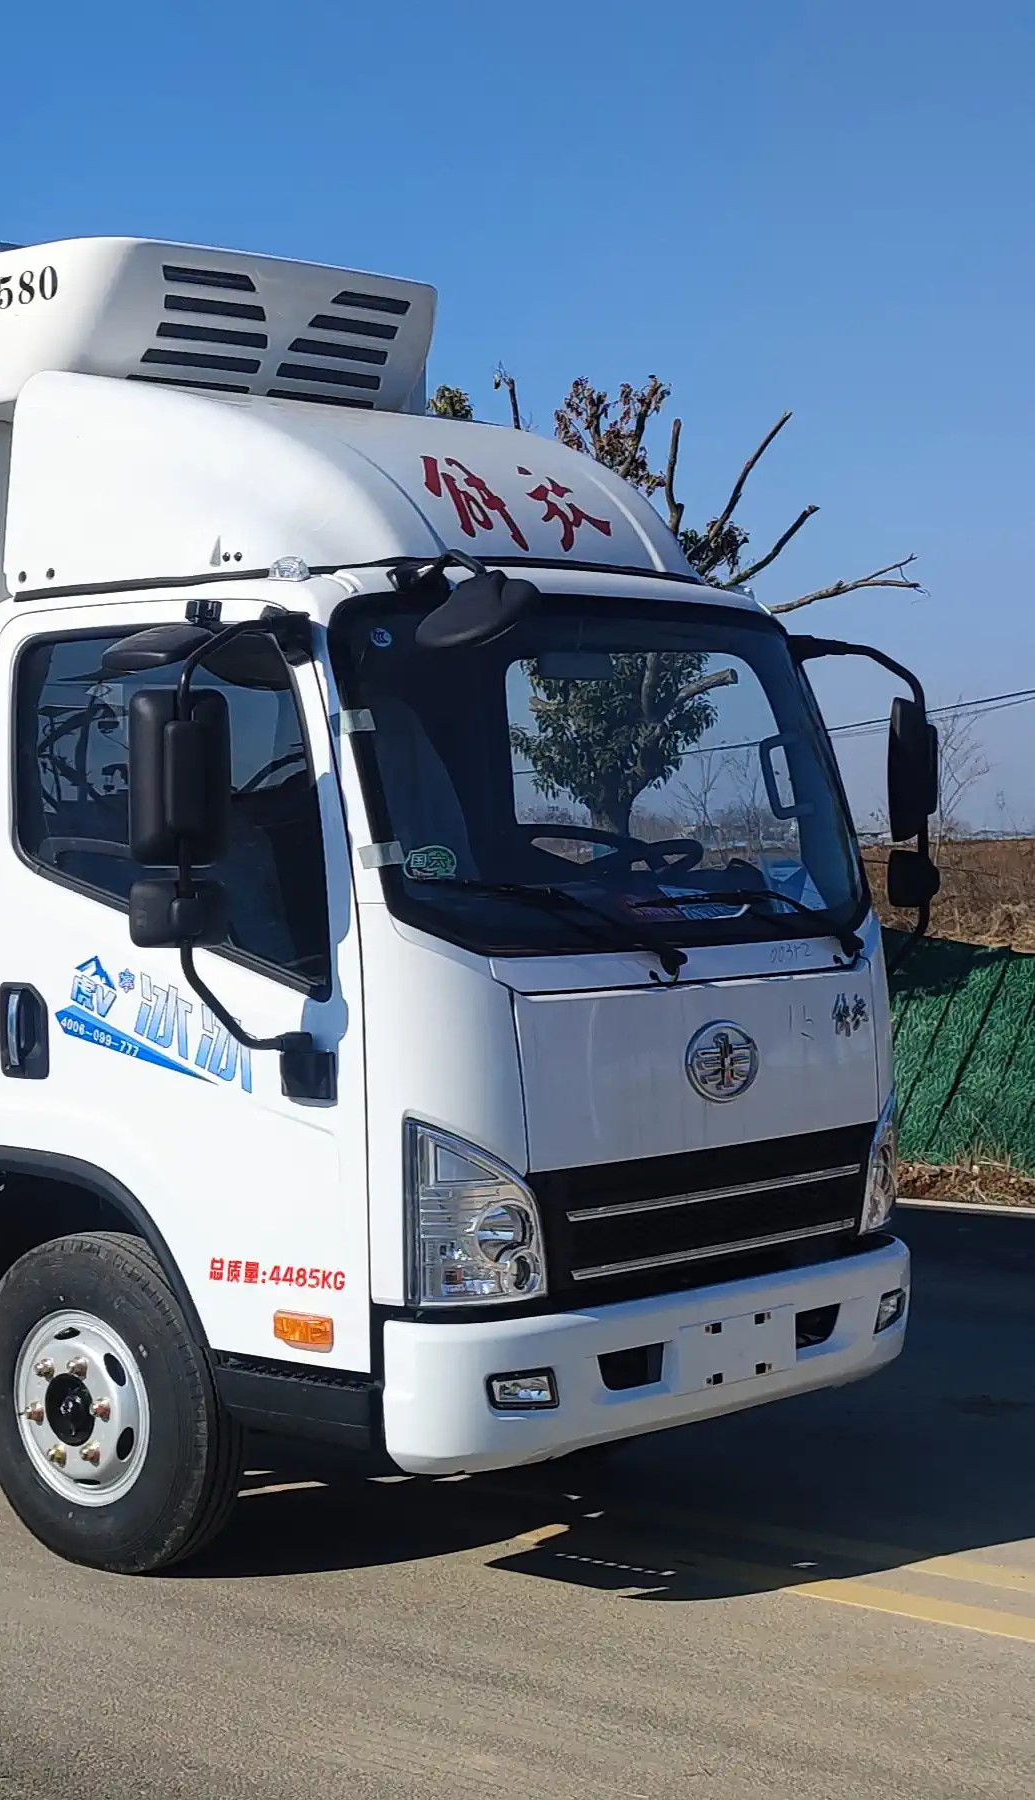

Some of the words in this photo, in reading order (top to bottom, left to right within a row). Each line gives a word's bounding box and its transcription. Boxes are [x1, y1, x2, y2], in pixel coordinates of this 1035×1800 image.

[409, 852, 447, 868] 国六
[209, 1257, 346, 1291] 总质量:4485KG
